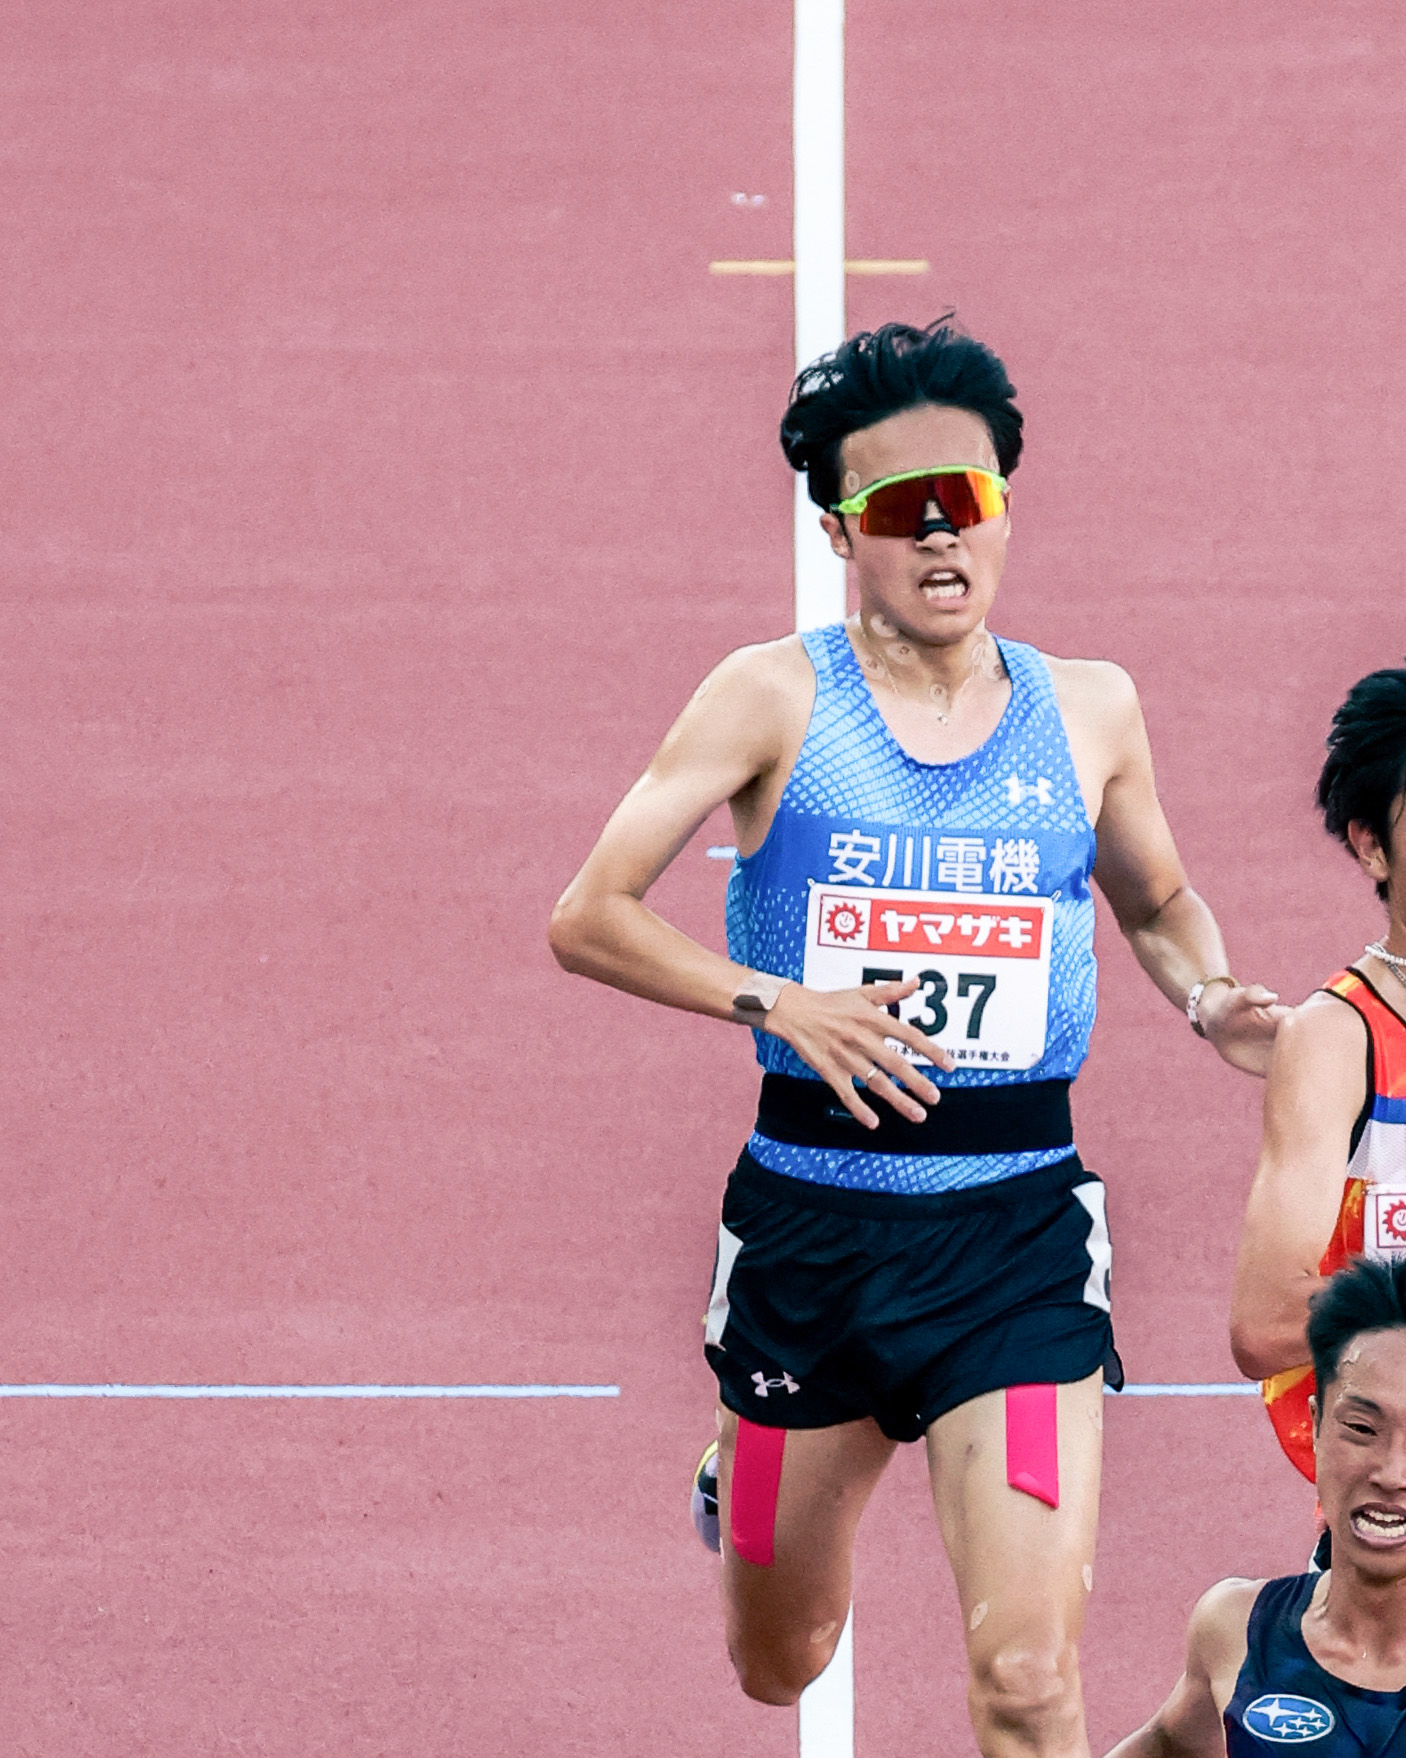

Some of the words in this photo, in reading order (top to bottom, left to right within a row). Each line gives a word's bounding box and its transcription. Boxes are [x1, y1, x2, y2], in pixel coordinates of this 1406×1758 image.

[827, 829, 1042, 894] 安川電機
[880, 909, 1034, 948] ヤマザキ
